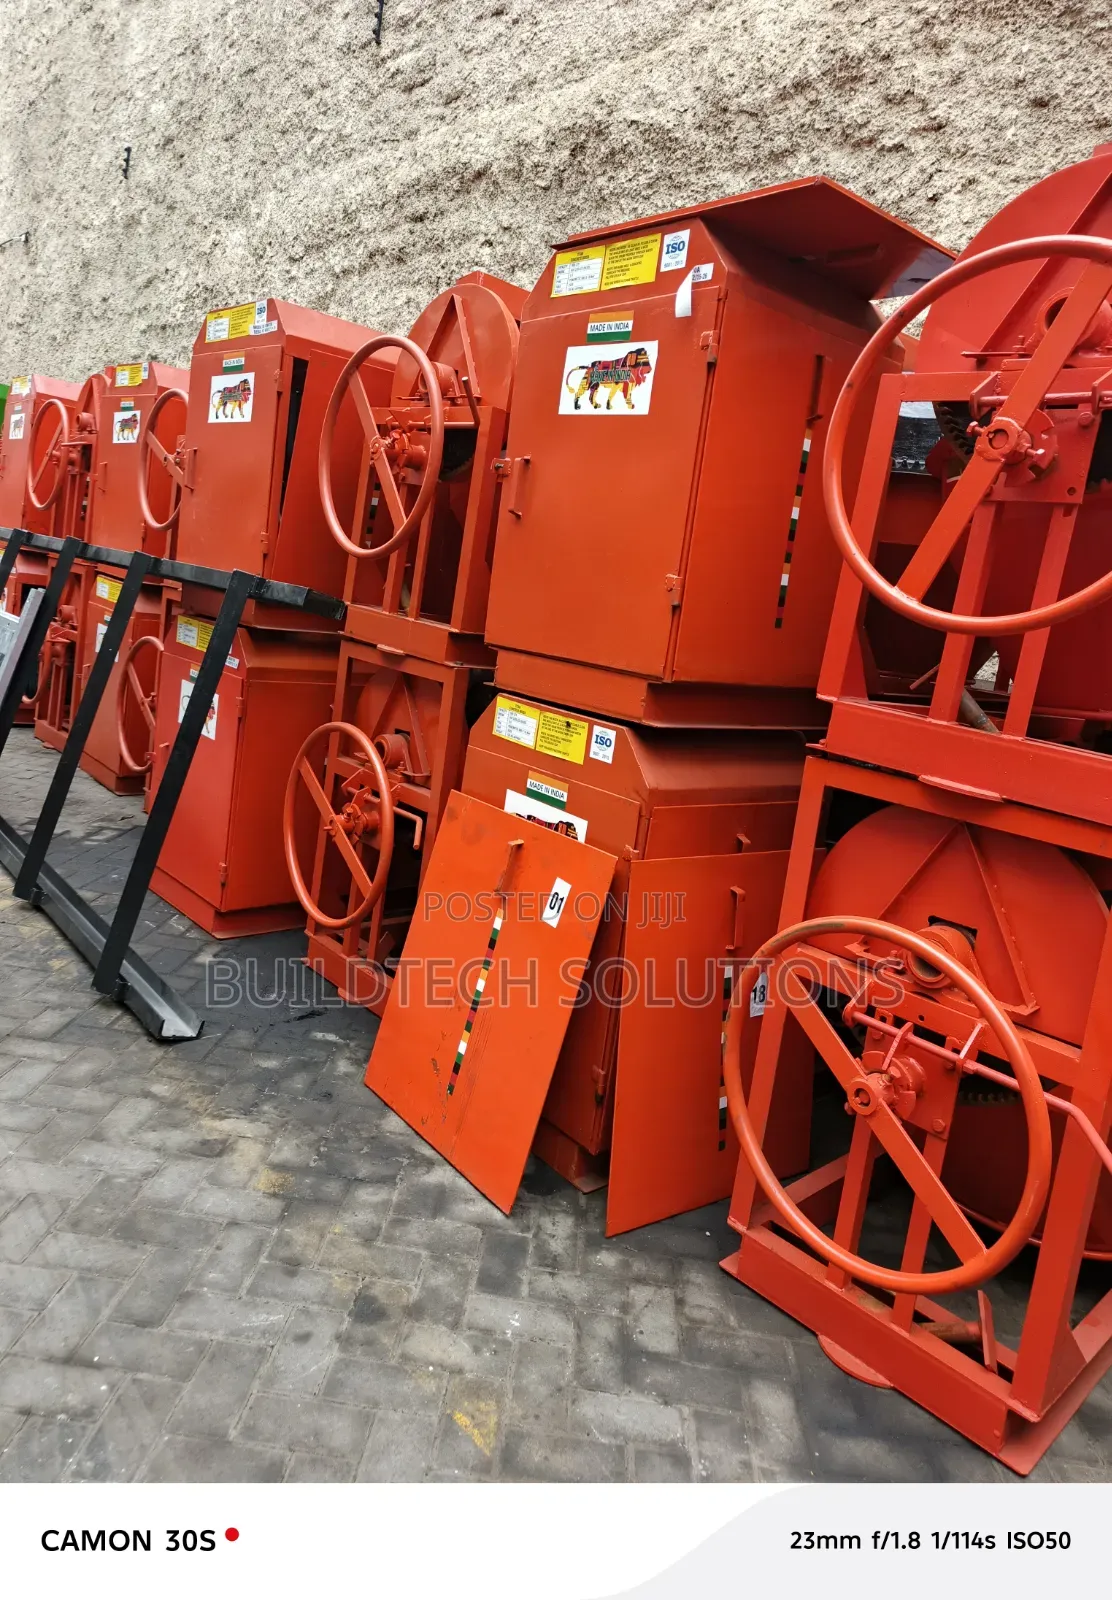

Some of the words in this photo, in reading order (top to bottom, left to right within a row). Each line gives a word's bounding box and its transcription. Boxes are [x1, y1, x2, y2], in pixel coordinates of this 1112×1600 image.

[665, 240, 685, 254] ISO
[590, 323, 606, 332] MADE
[606, 322, 613, 331] IN
[614, 322, 629, 330] INDIA
[594, 734, 612, 747] ISO
[529, 781, 543, 792] MADE
[544, 785, 550, 794] IN
[551, 787, 564, 799] INDIA
[549, 892, 565, 913] 01
[752, 985, 766, 1004] 18
